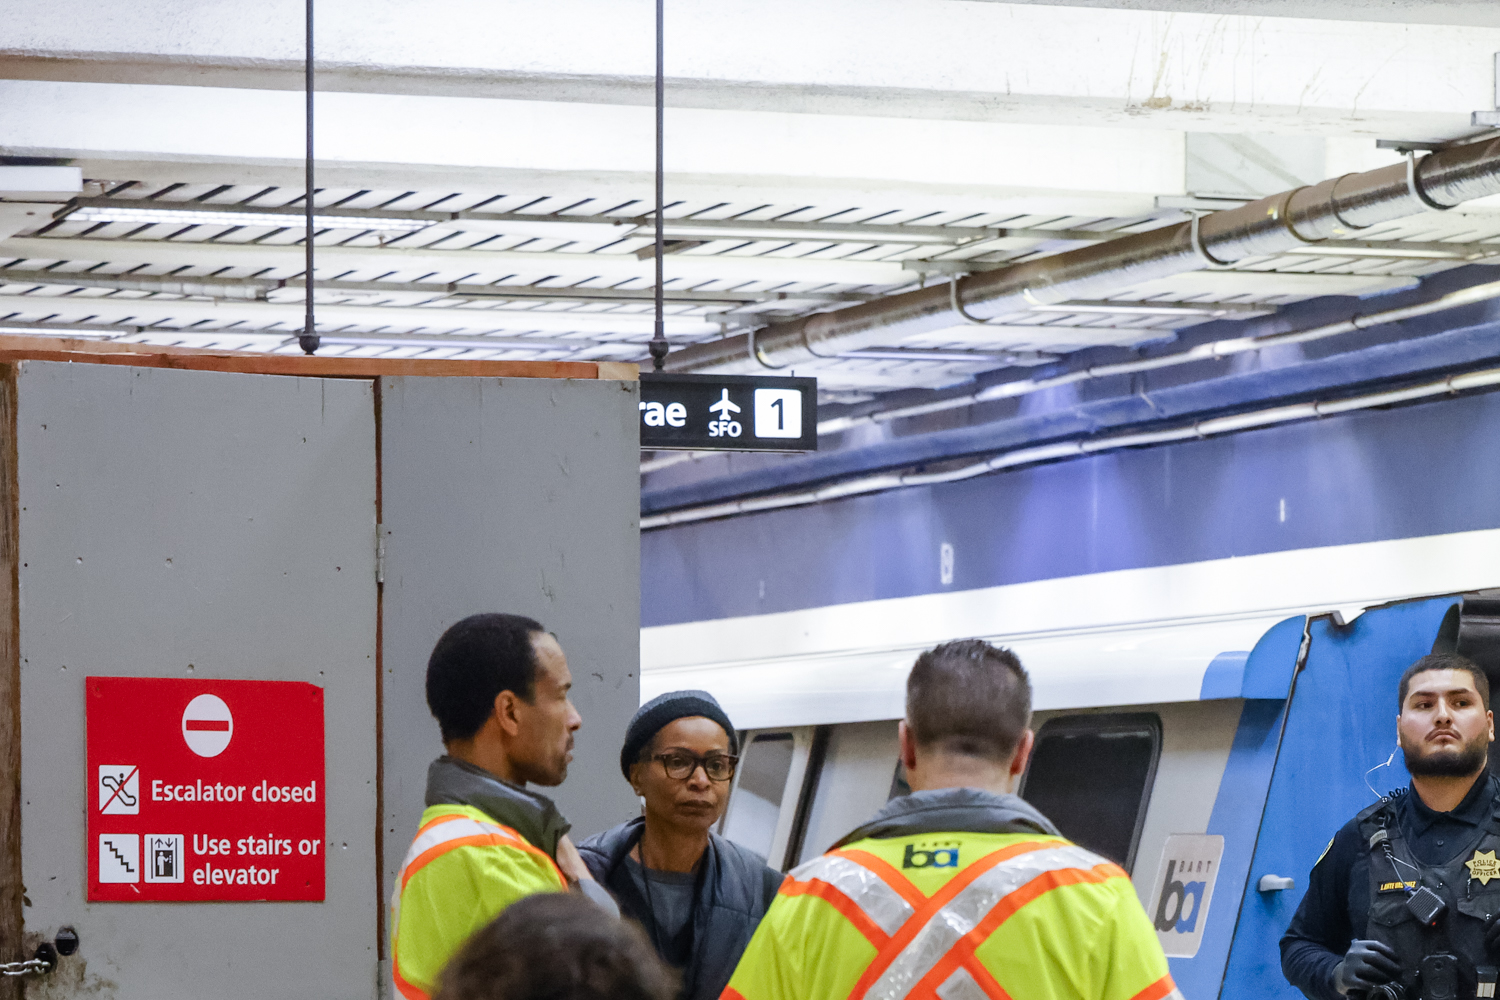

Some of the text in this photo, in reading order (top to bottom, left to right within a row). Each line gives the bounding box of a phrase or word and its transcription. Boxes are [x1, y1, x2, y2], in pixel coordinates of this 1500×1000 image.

[770, 398, 784, 431] 1
[708, 420, 743, 438] SFO
[151, 778, 317, 803] Escalator closed
[192, 833, 321, 856] Use stairs or
[192, 862, 280, 885] elevator
[1179, 860, 1212, 873] BART
[1471, 869, 1498, 877] OFFICER
